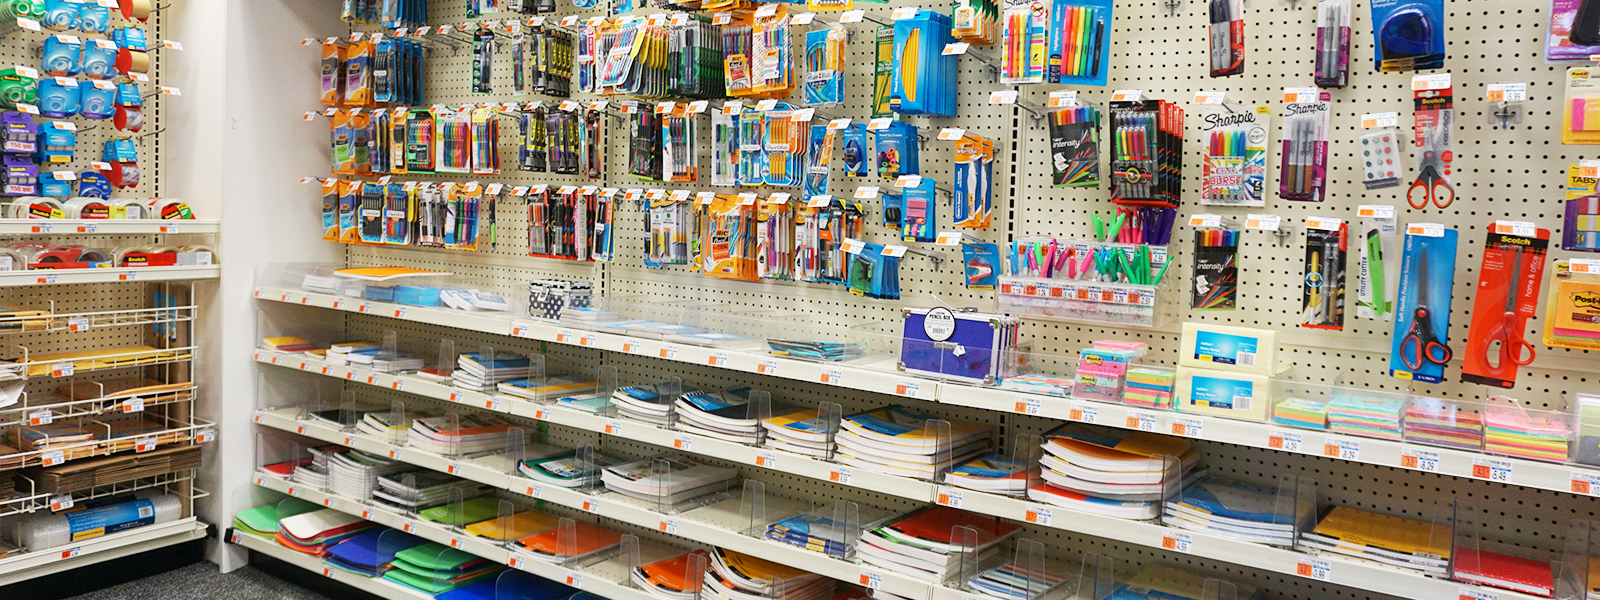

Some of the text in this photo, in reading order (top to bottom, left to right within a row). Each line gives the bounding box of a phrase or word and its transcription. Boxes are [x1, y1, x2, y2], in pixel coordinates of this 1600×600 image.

[1285, 102, 1328, 117] Sharpie
[1204, 111, 1255, 131] Sharpie
[1210, 176, 1242, 185] BURST
[32, 208, 50, 218] Scotch
[1501, 236, 1531, 245] Scotch
[1525, 280, 1534, 297] home
[1530, 256, 1539, 273] office
